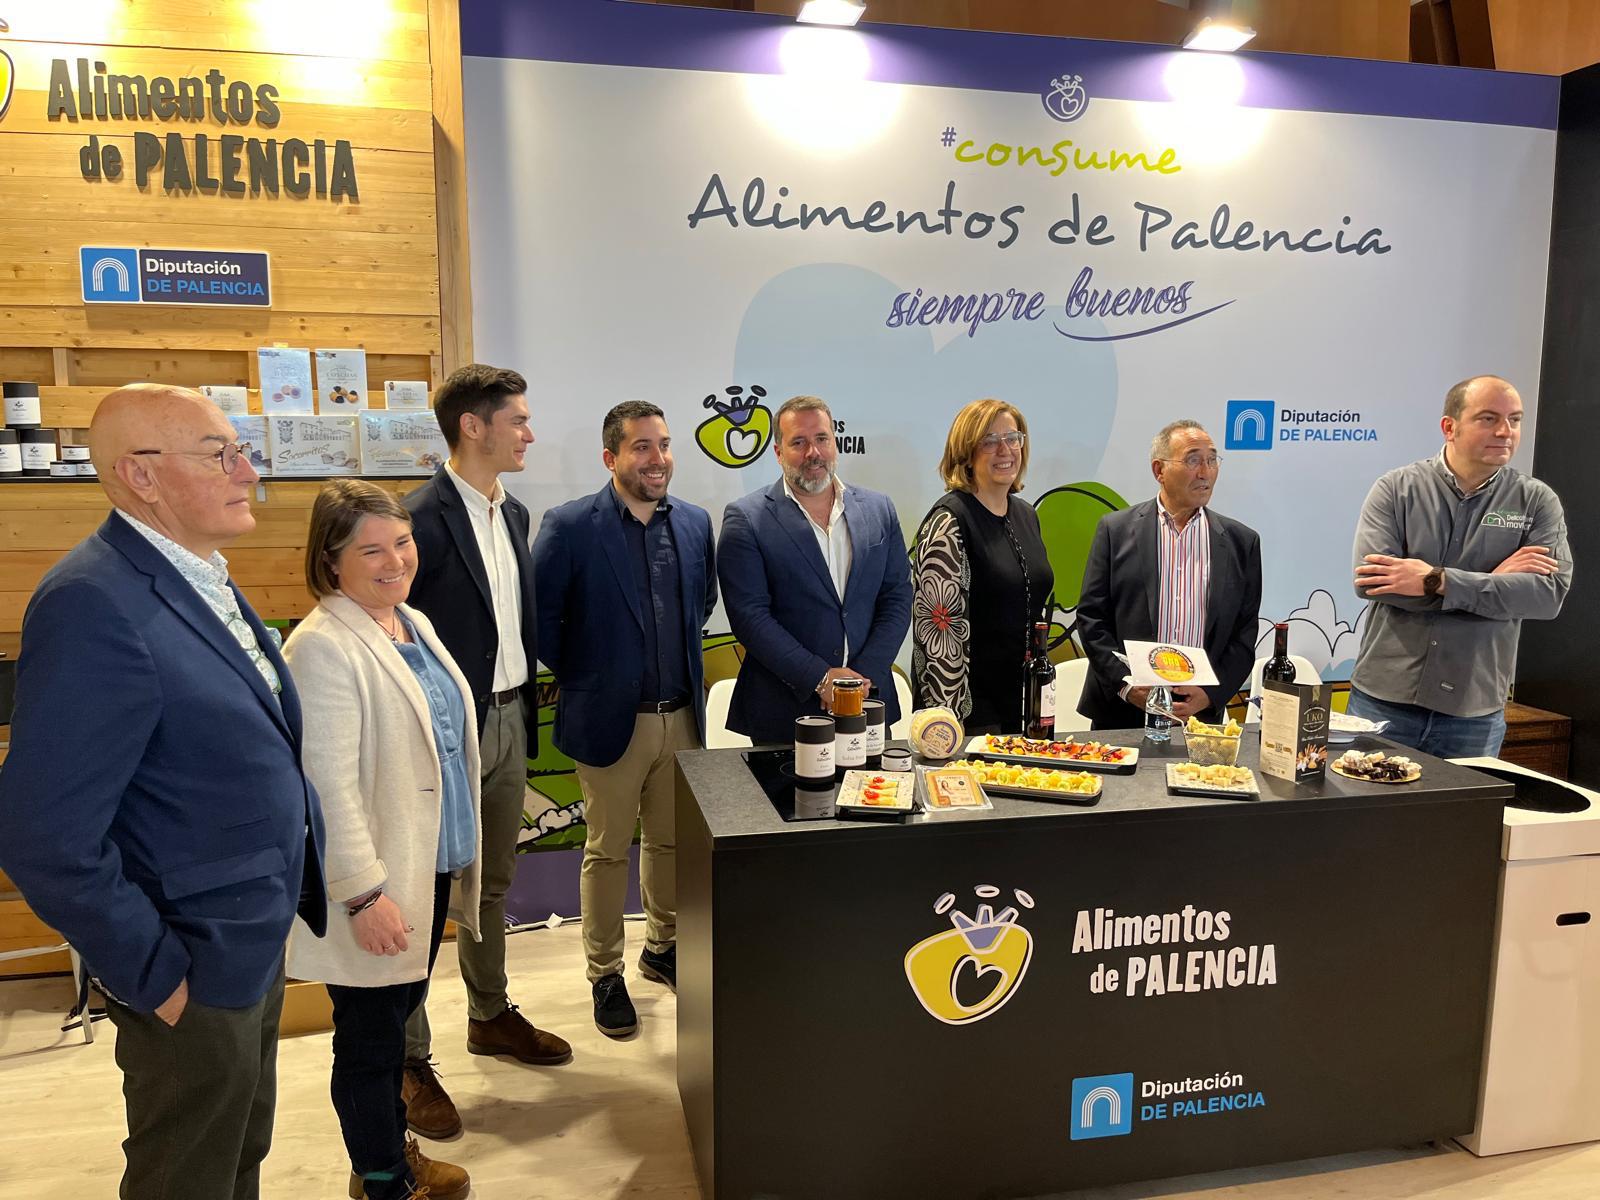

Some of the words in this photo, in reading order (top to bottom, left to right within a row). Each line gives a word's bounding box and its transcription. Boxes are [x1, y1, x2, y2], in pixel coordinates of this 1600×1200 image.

[47, 58, 281, 128] Alimentos
[79, 134, 123, 181] de
[134, 131, 360, 202] PALENCIA
[941, 125, 1182, 177] #consume
[687, 173, 1024, 250] Alimentos
[1048, 193, 1115, 246] de
[1134, 201, 1392, 257] Palencia
[146, 257, 242, 278] Diputación
[147, 278, 172, 294] DE
[176, 279, 265, 297] PALENCIA
[886, 284, 1047, 338] siempre
[1058, 266, 1202, 336] buenos
[1279, 429, 1301, 441] DE
[1304, 429, 1378, 441] PALENCIA
[1280, 409, 1361, 425] Diputación
[1071, 904, 1232, 955] Alimentos
[1089, 963, 1119, 995] de
[1125, 944, 1278, 998] PALENCIA
[1140, 1102, 1168, 1122] DE
[1172, 1091, 1266, 1119] PALENCIA
[1141, 1071, 1244, 1100] Diputación
